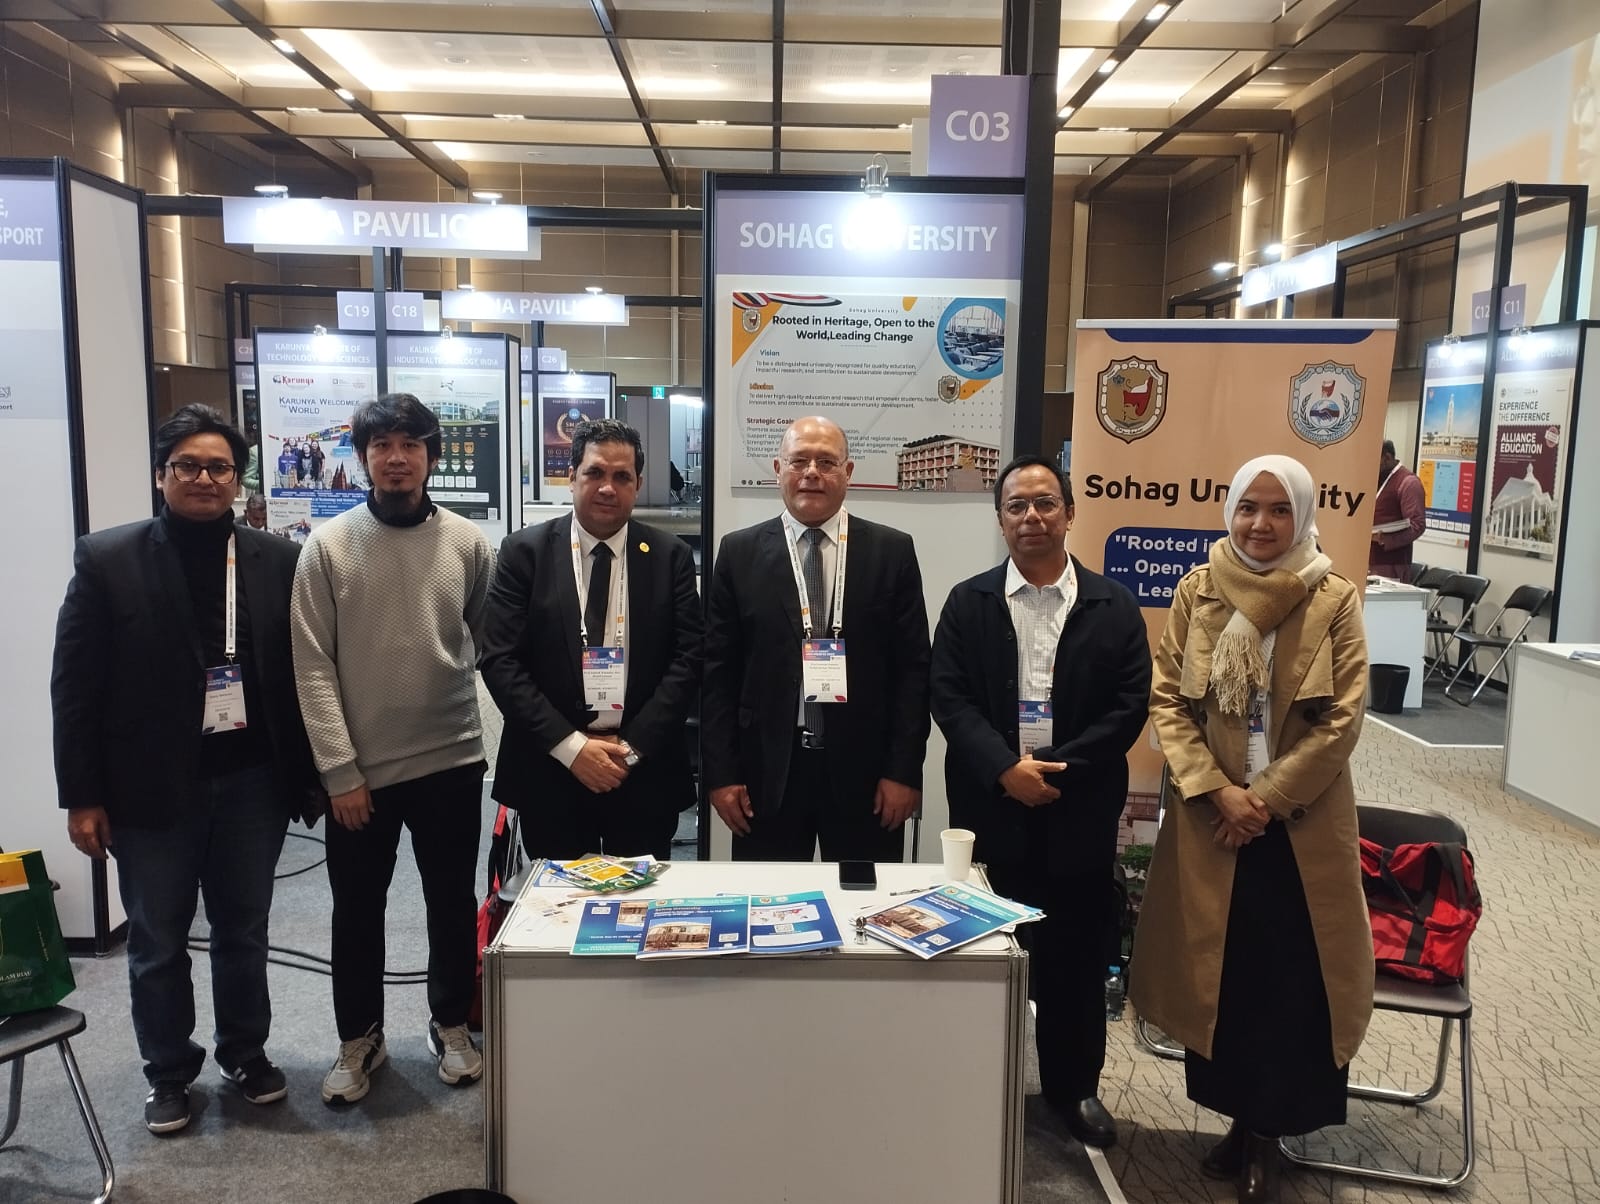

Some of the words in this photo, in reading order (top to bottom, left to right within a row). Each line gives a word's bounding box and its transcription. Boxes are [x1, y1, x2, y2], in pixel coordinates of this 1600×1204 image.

[945, 110, 1011, 142] C03
[352, 210, 486, 239] PAVILIO
[739, 222, 833, 249] SOHAG
[344, 304, 370, 318] C19
[391, 304, 418, 318] C18
[520, 299, 592, 317] PAVILI
[1474, 305, 1491, 319] C12
[1503, 300, 1521, 315] C11
[772, 315, 810, 326] Rooted
[812, 315, 822, 326] in
[824, 315, 872, 329] Heritage,
[874, 317, 902, 328] Open
[904, 318, 916, 328] to
[917, 318, 935, 328] the
[873, 331, 914, 343] Change
[541, 355, 558, 364] C26
[759, 349, 780, 357] Vision
[282, 375, 314, 386] Karunya
[1499, 401, 1539, 411] EXPERIENCE
[746, 417, 776, 425] Strategic
[1510, 412, 1550, 421] DIFFERENCE
[1501, 432, 1537, 443] ALLIANCE
[1500, 443, 1543, 454] EDUCATION
[1085, 474, 1179, 507] Sohag
[1134, 559, 1184, 577] Open
[0, 973, 16, 983] LAM
